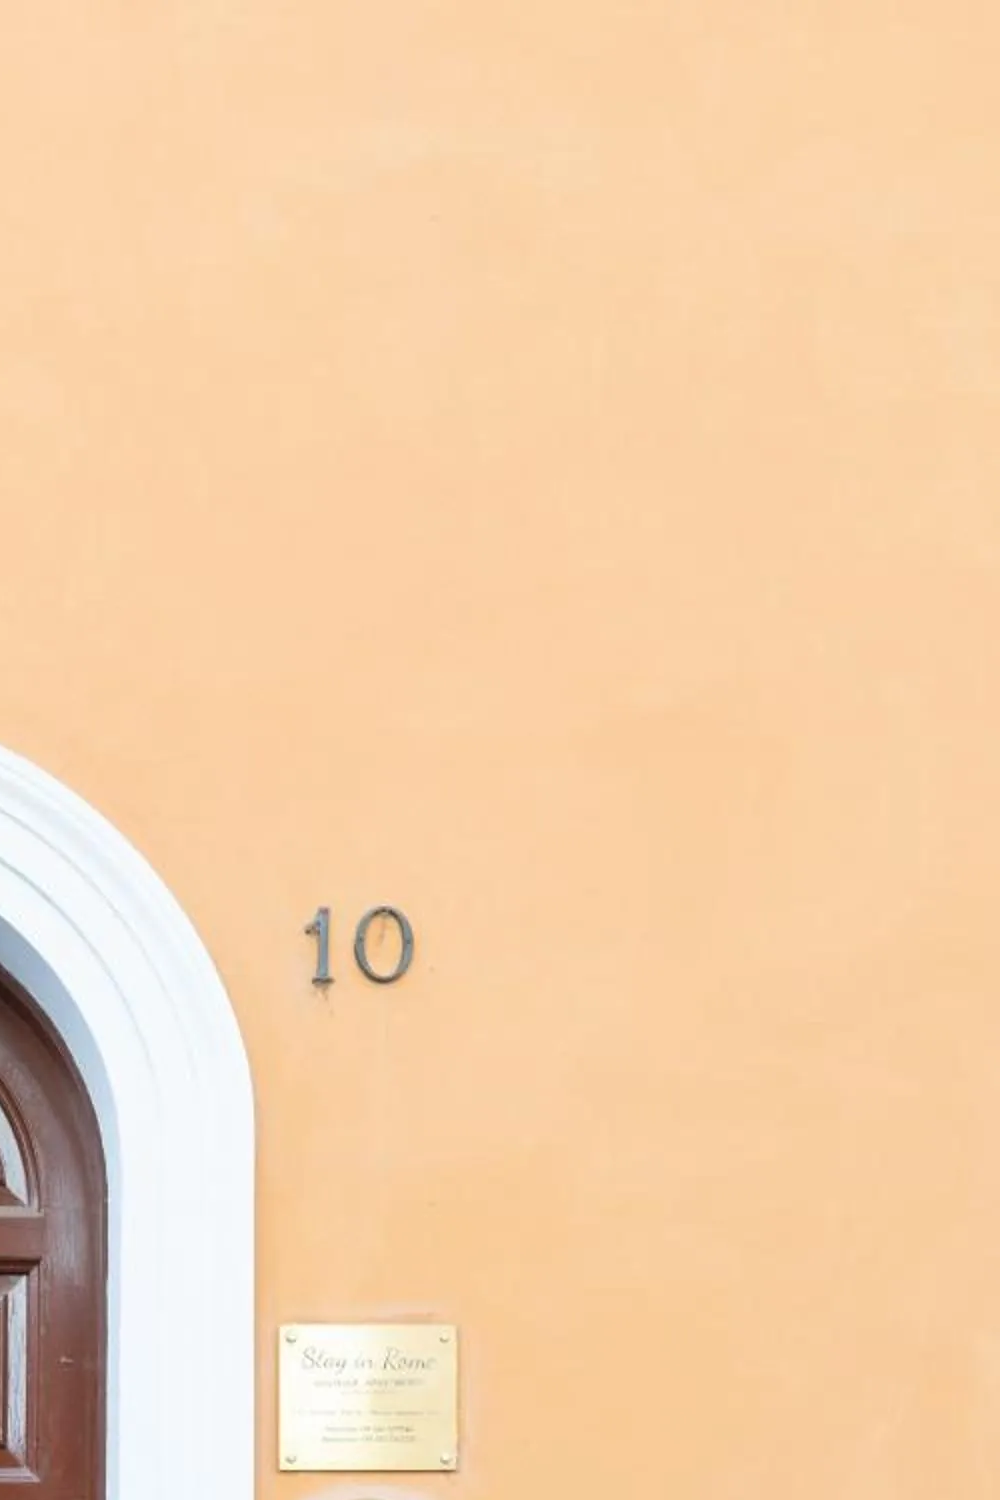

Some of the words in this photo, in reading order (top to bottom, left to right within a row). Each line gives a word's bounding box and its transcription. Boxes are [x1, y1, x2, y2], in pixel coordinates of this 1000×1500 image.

[304, 907, 413, 984] 10
[301, 1346, 347, 1375] Stay
[354, 1350, 373, 1370] in
[382, 1346, 438, 1371] Rome
